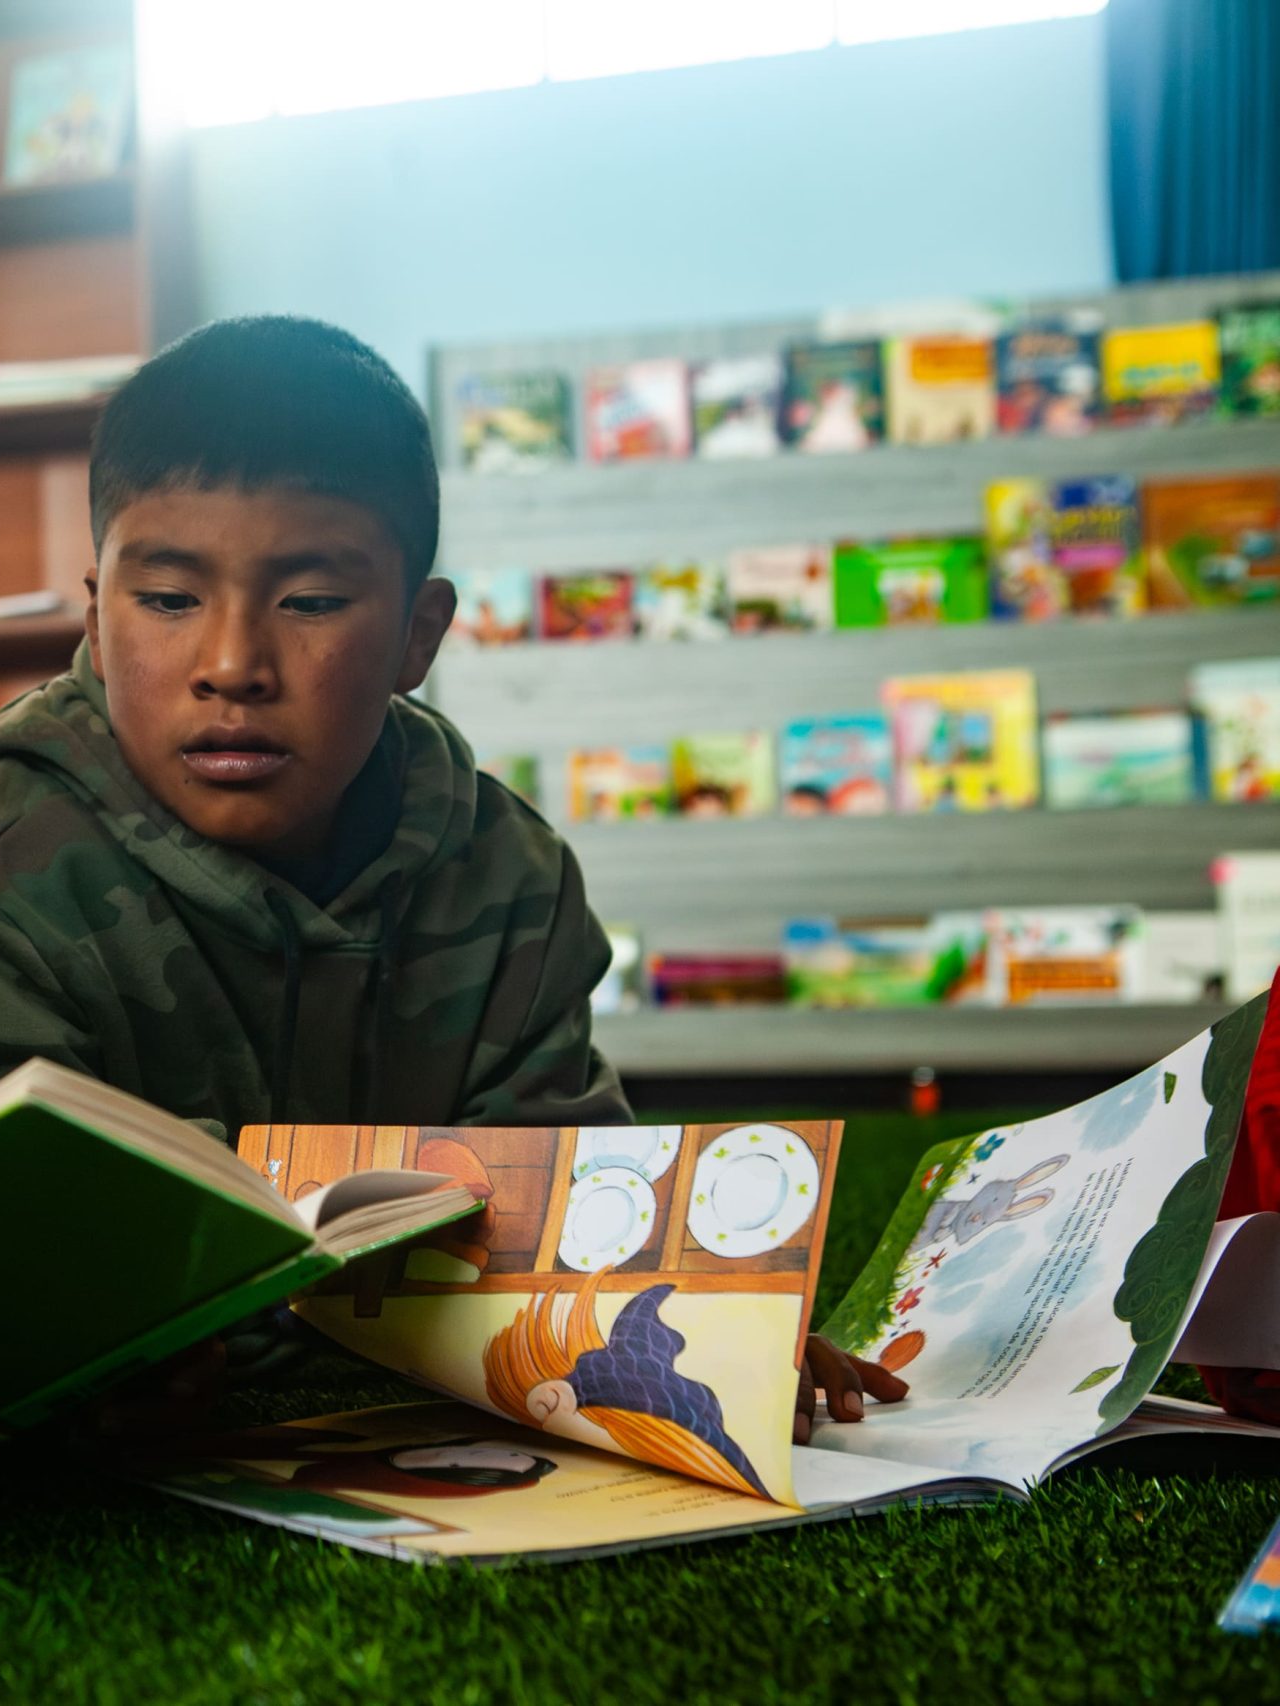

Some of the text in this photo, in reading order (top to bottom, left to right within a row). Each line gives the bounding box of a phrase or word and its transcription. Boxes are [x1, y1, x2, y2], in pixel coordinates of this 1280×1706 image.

[1092, 1162, 1122, 1217] Caperucita
[1107, 1190, 1120, 1209] una
[1056, 1211, 1077, 1242] hecho
[1073, 1208, 1089, 1231] casa
[1098, 1211, 1110, 1230] vez
[1048, 1244, 1059, 1256] su
[1053, 1232, 1078, 1267] llevaba
[1088, 1230, 1100, 1250] una
[1070, 1246, 1082, 1259] Le
[1041, 1268, 1056, 1286] una
[1061, 1274, 1078, 1294] muy
[1017, 1288, 1045, 1329] capucha
[1046, 1297, 1064, 1324] dulce
[1008, 1332, 1019, 1344] de
[1021, 1312, 1044, 1345] porque
[992, 1346, 1010, 1368] color
[1022, 1335, 1043, 1361] quien
[992, 1348, 1022, 1382] siempre
[975, 1370, 992, 1386] rojo
